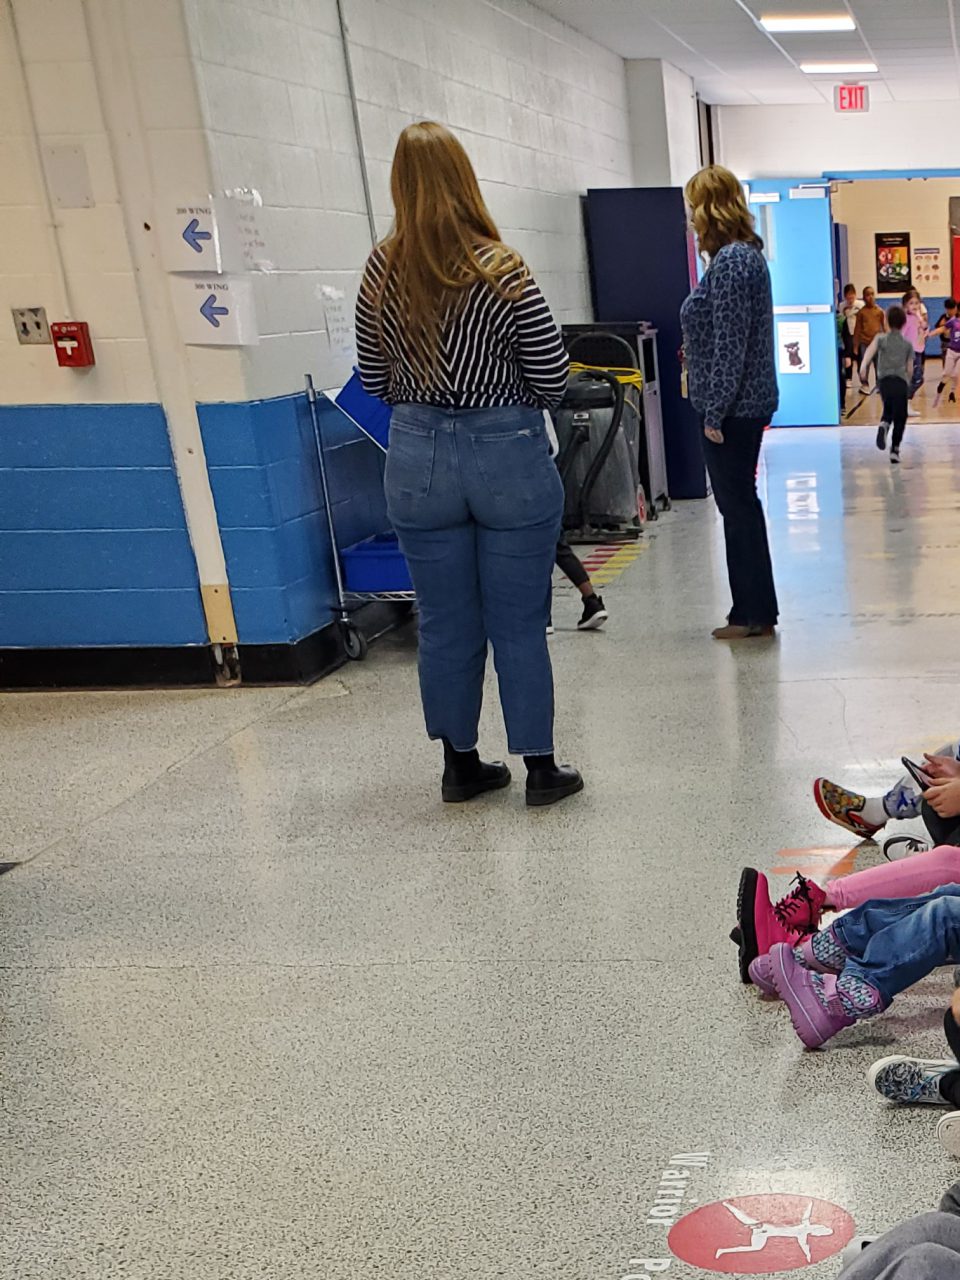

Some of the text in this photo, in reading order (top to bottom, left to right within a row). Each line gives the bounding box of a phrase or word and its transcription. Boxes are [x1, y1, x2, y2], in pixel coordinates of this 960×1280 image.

[840, 86, 864, 110] EXIT
[188, 207, 211, 215] WING
[206, 283, 229, 291] WING
[646, 1151, 711, 1227] Warrior
